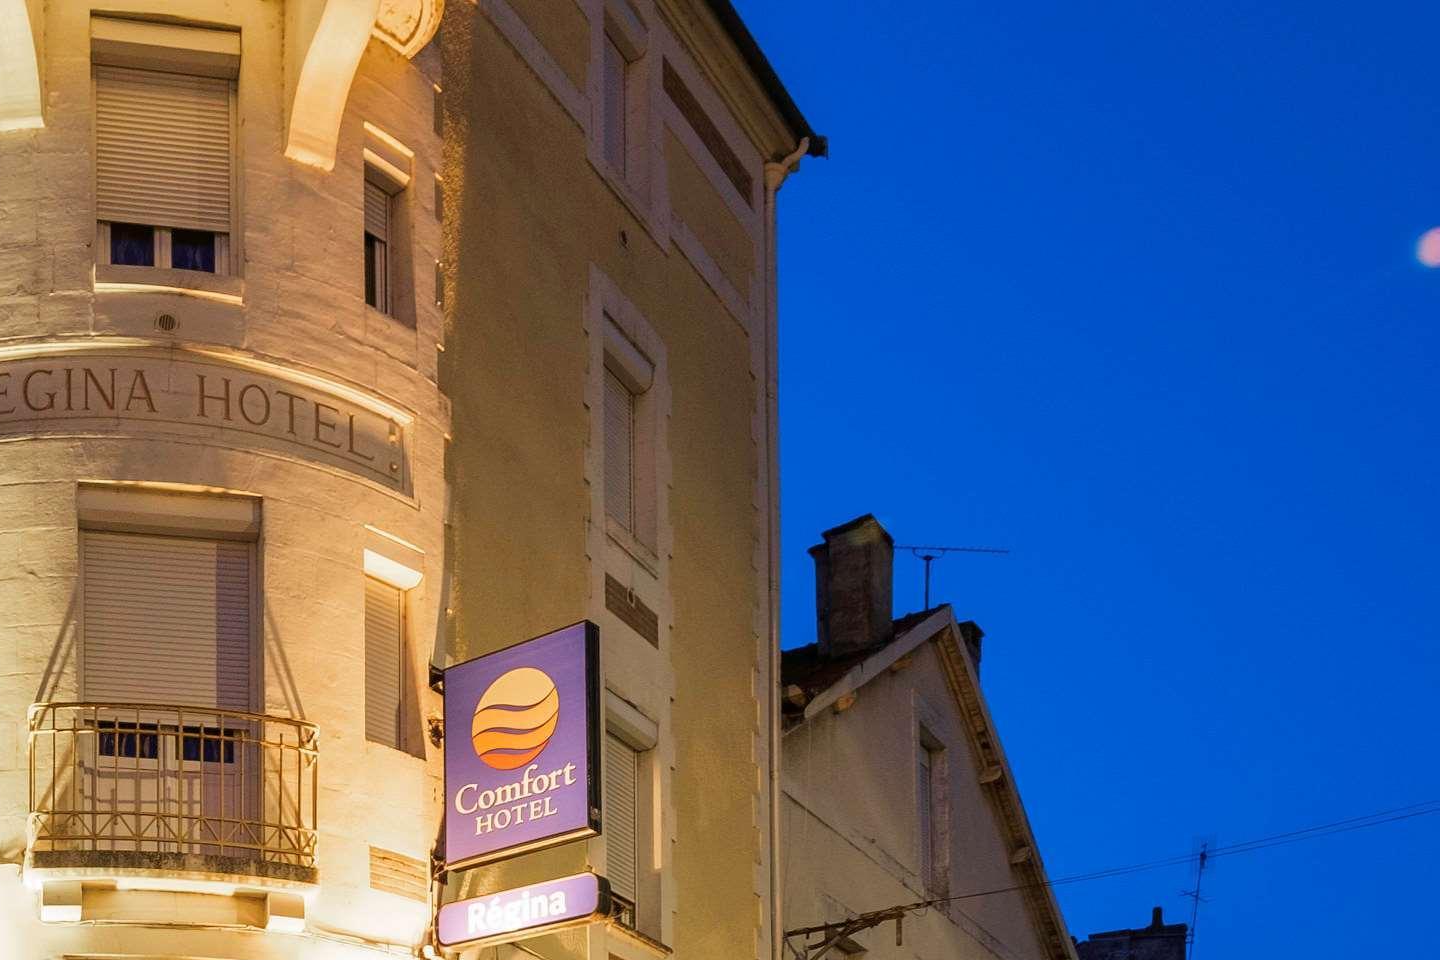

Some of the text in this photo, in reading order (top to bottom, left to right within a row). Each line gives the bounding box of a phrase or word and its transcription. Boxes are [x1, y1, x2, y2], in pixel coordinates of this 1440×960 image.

[196, 373, 376, 461] HOTEL
[454, 761, 577, 816] Comfort
[474, 796, 559, 836] HOTEL
[466, 889, 568, 935] Régina
